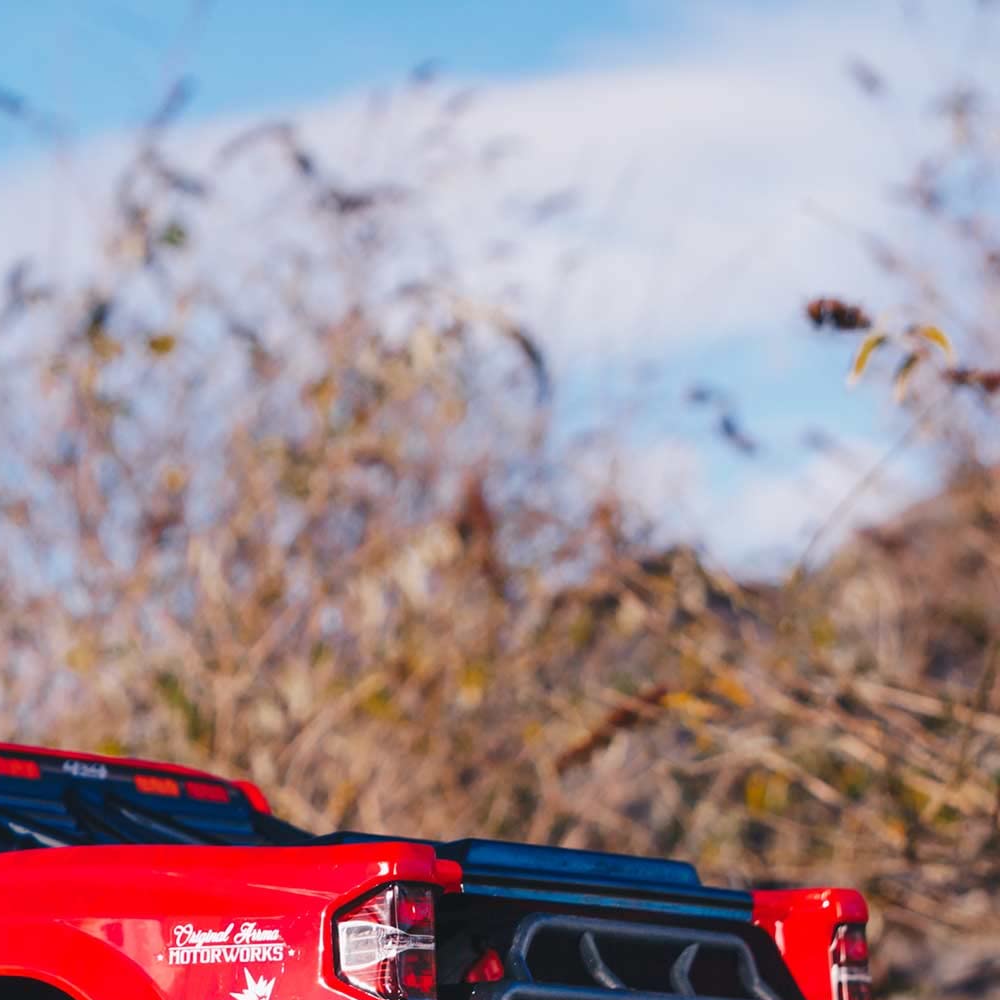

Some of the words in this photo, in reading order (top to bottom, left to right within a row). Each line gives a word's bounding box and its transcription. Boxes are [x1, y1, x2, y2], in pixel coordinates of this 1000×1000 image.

[173, 923, 234, 948] Original
[234, 922, 281, 944] Arrma
[168, 946, 284, 965] MOTORWORKS
